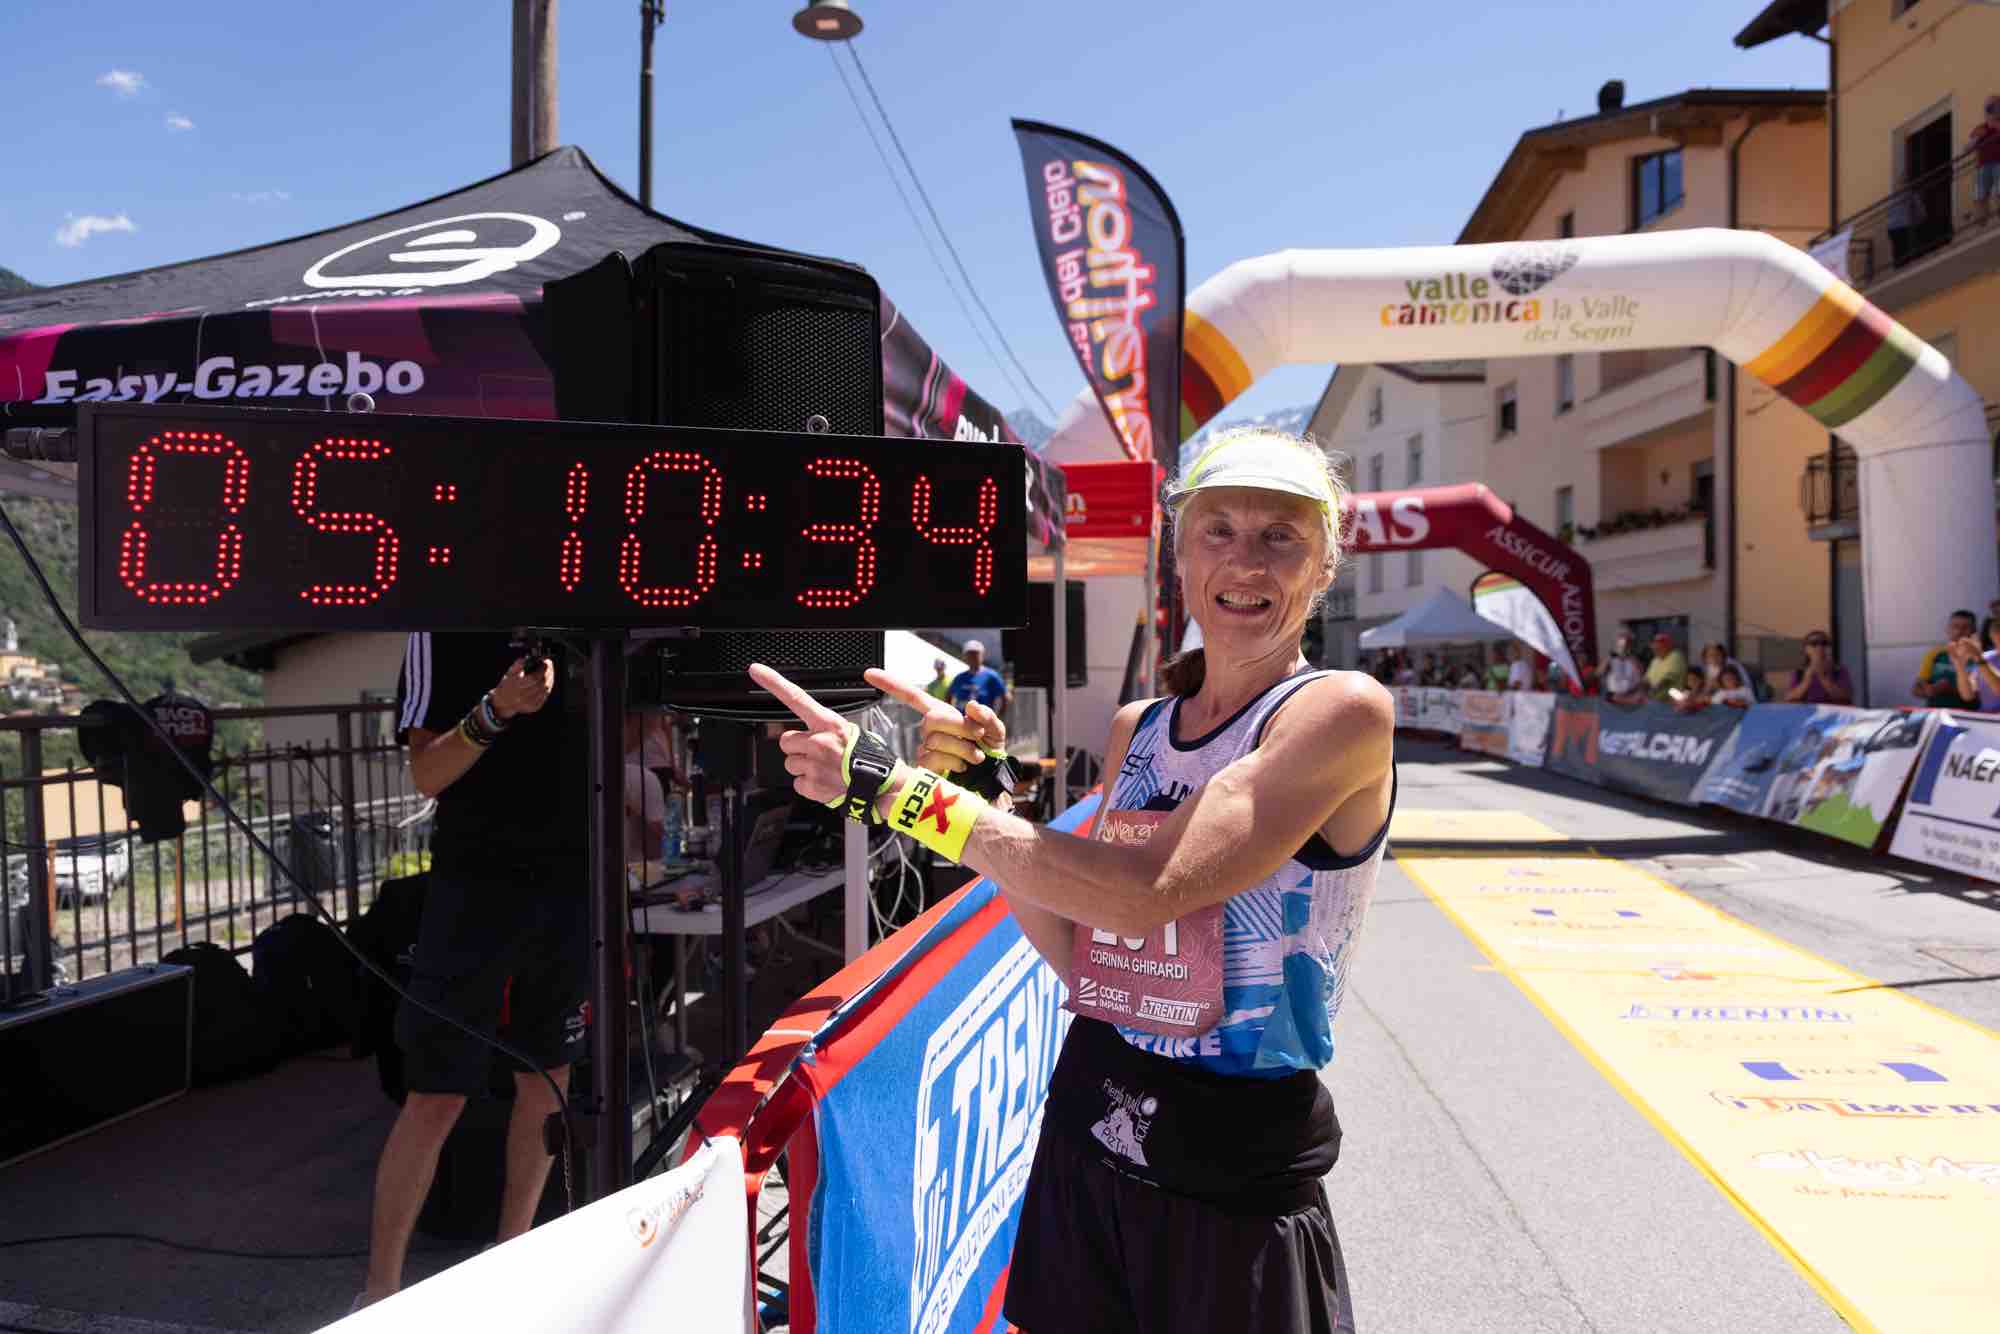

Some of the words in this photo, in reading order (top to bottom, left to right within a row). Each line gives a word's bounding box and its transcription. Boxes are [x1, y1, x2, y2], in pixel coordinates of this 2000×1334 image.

[1405, 272, 1491, 301] valle
[1379, 298, 1542, 328] camonica
[1552, 299, 1573, 321] la
[1582, 296, 1640, 320] Valle
[1523, 324, 1560, 344] dei
[1570, 321, 1634, 343] Segni
[32, 352, 425, 405] Easy-Gazebo
[897, 772, 939, 829] TECH
[1090, 950, 1131, 971] CORINNA
[1132, 957, 1189, 980] GHIRARDI
